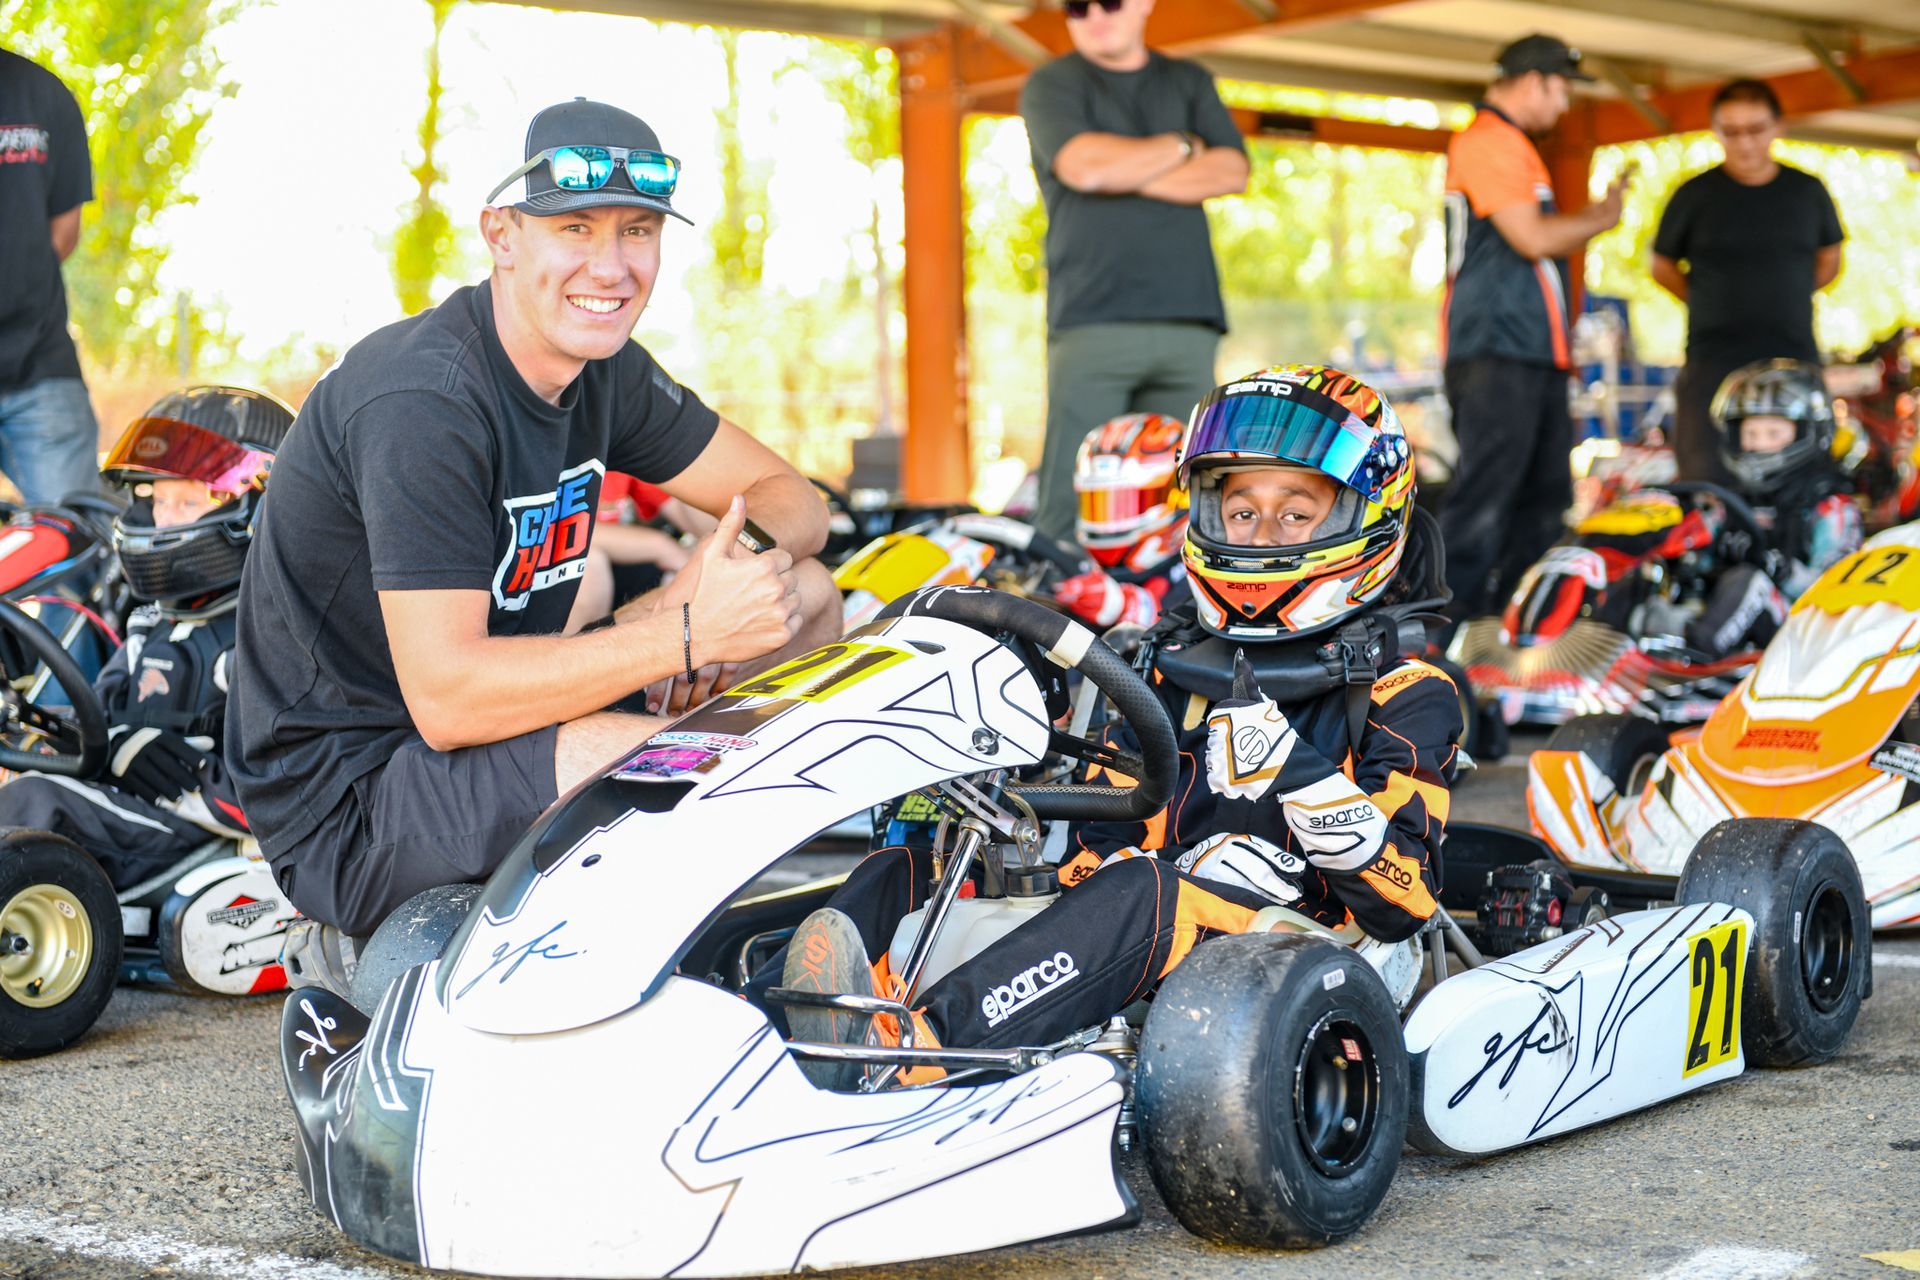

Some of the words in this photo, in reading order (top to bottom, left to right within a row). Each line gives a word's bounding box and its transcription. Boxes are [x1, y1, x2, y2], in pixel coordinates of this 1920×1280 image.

[1224, 381, 1293, 397] zamp
[1839, 551, 1909, 585] 12
[1226, 581, 1267, 592] zamp
[733, 645, 898, 698] 21
[1373, 669, 1432, 693] sparco
[1309, 804, 1375, 829] sparco
[1368, 857, 1412, 890] arco
[982, 951, 1080, 1028] sparco
[1686, 928, 1738, 1071] 21
